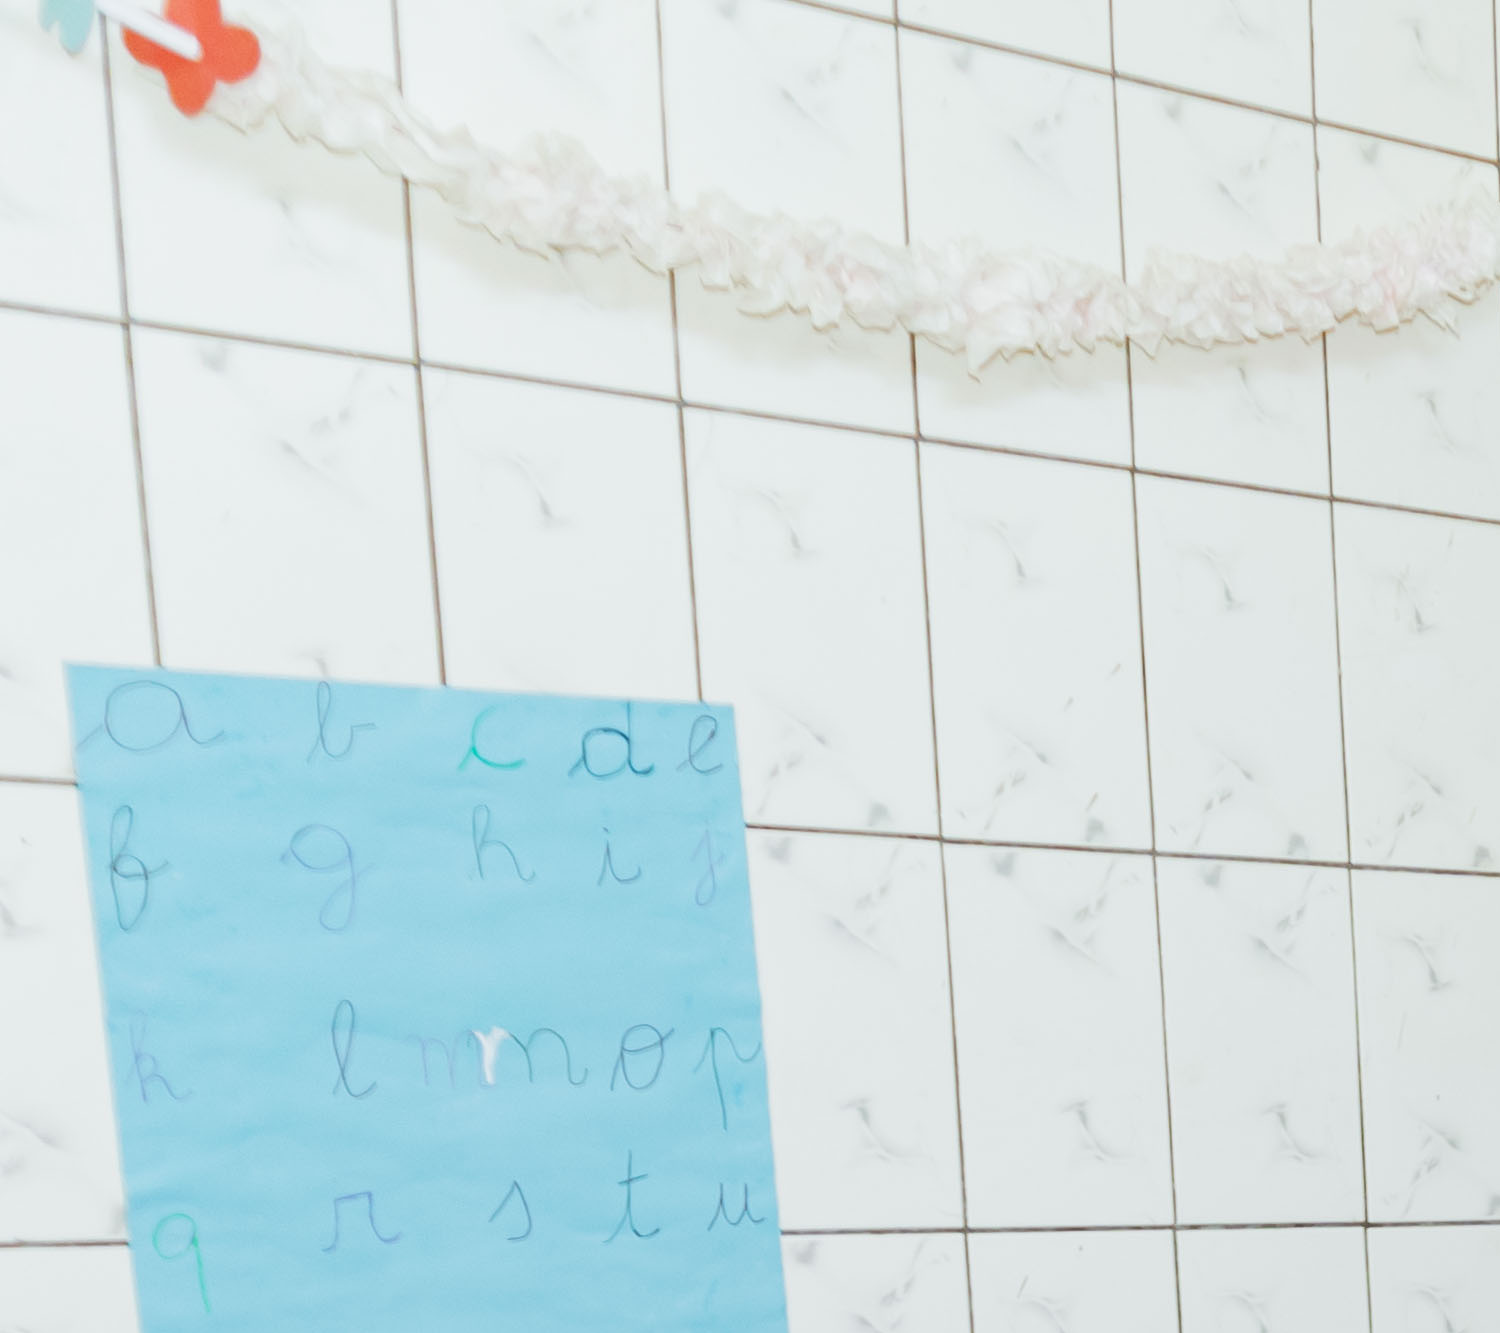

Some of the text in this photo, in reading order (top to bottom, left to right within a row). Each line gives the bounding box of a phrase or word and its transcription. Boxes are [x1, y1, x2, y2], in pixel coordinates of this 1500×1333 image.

[308, 682, 376, 762] b
[458, 707, 526, 771] c
[568, 701, 655, 779] d
[677, 715, 731, 774] e
[280, 824, 372, 931] g
[471, 803, 536, 883] h
[598, 826, 642, 884] i
[331, 999, 377, 1098] l
[693, 1026, 761, 1130] p
[322, 1190, 402, 1252] r
[487, 1180, 532, 1241] s
[603, 1149, 661, 1242] t
[706, 1181, 765, 1231] u
